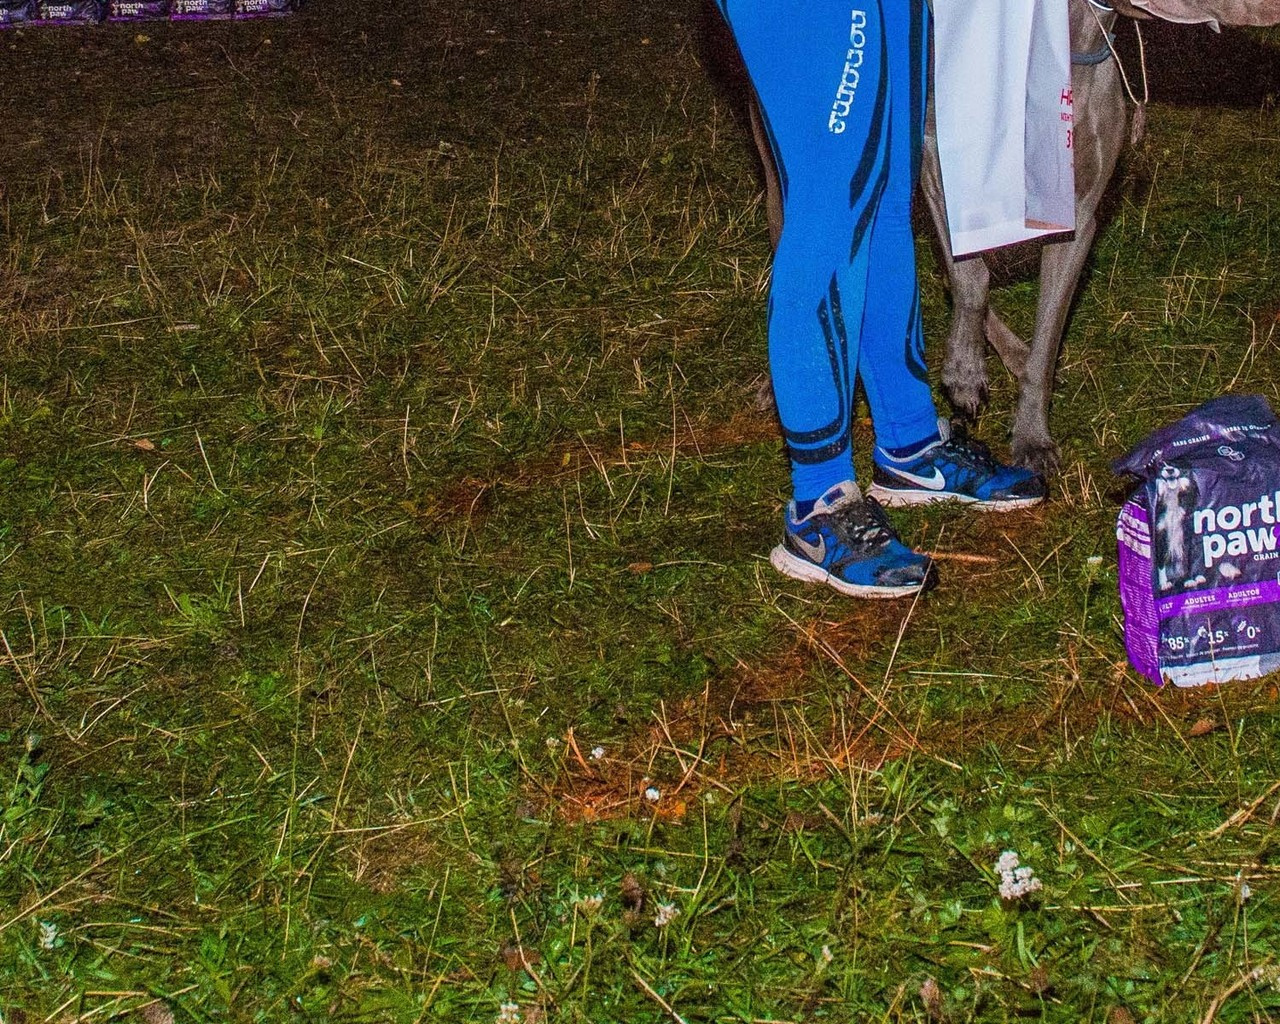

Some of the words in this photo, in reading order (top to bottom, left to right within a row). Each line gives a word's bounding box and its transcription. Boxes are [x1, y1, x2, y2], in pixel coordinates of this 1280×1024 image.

[48, 4, 72, 12] north
[120, 2, 143, 10] north
[49, 10, 68, 18] paw
[121, 8, 139, 16] paw
[827, 9, 866, 134] noname
[1203, 526, 1278, 568] paw
[1253, 551, 1279, 561] GRAIN
[1184, 595, 1216, 606] ADULTES
[1228, 588, 1260, 599] ADULTOS
